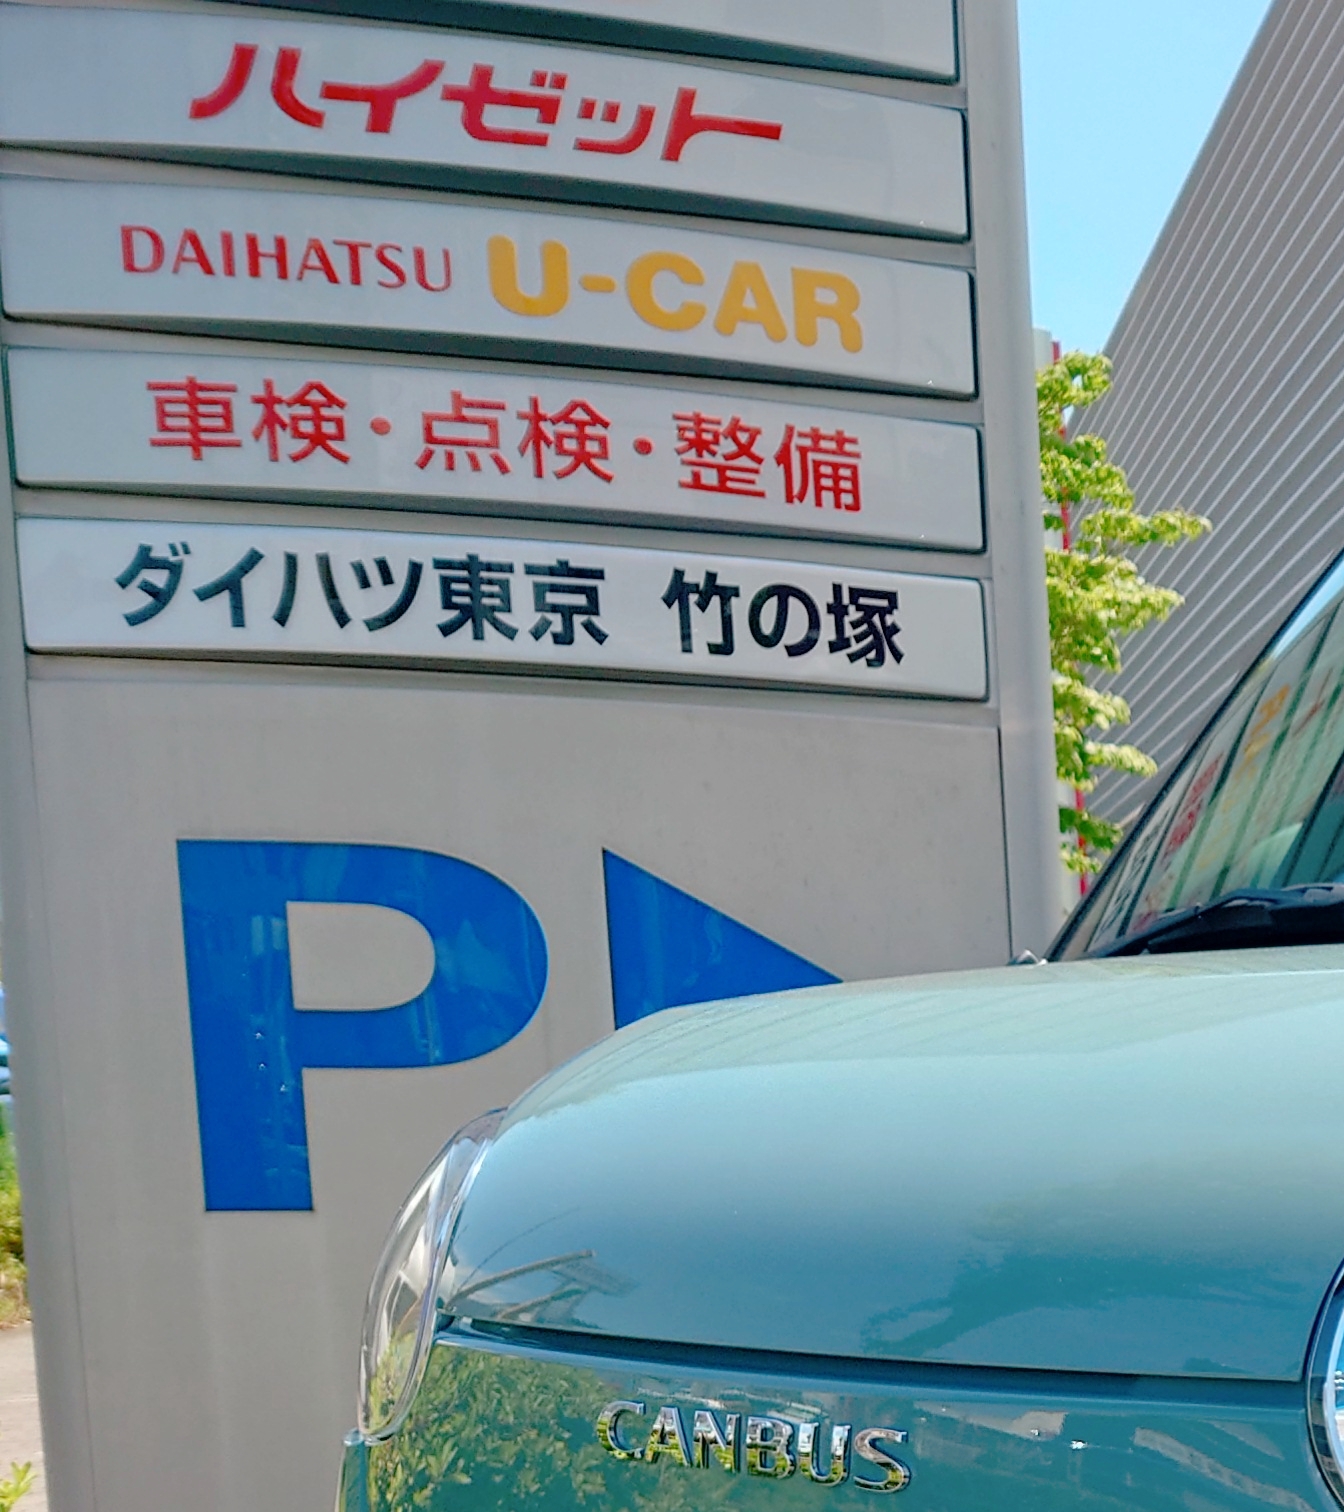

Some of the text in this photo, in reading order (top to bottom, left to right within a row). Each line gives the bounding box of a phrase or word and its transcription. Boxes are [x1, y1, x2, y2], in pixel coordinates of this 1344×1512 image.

[189, 43, 783, 162] ハイゼット
[121, 225, 864, 353] DAIHATSU U-CAR
[147, 376, 863, 514] 車検・点検・整備
[115, 542, 905, 670] ダイハツ東京 竹の塚
[176, 839, 549, 1212] P
[597, 1399, 909, 1494] CANBUS
